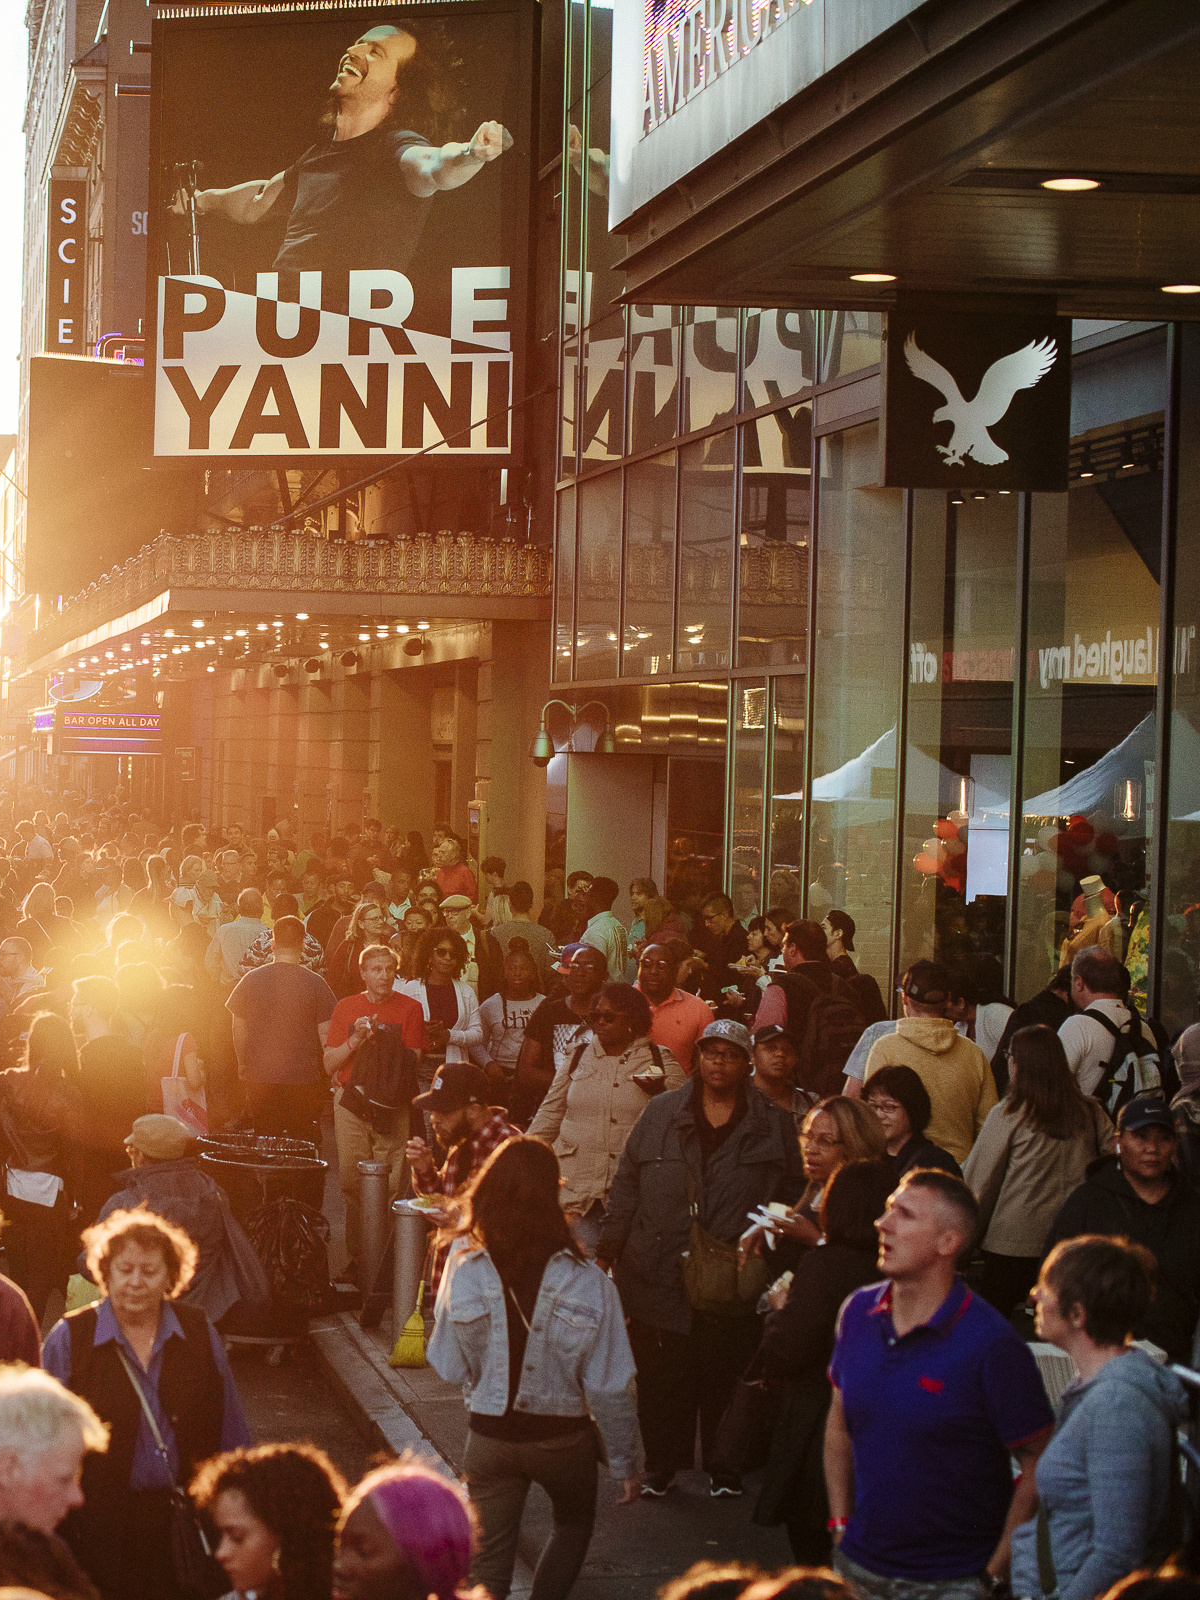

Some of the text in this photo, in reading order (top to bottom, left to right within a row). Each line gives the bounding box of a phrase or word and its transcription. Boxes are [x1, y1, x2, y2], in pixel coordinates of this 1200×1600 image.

[58, 198, 77, 344] SCIE
[163, 267, 511, 360] PURE
[163, 361, 510, 450] YANNI
[64, 716, 160, 727] BAR OPEN ALL DAY
